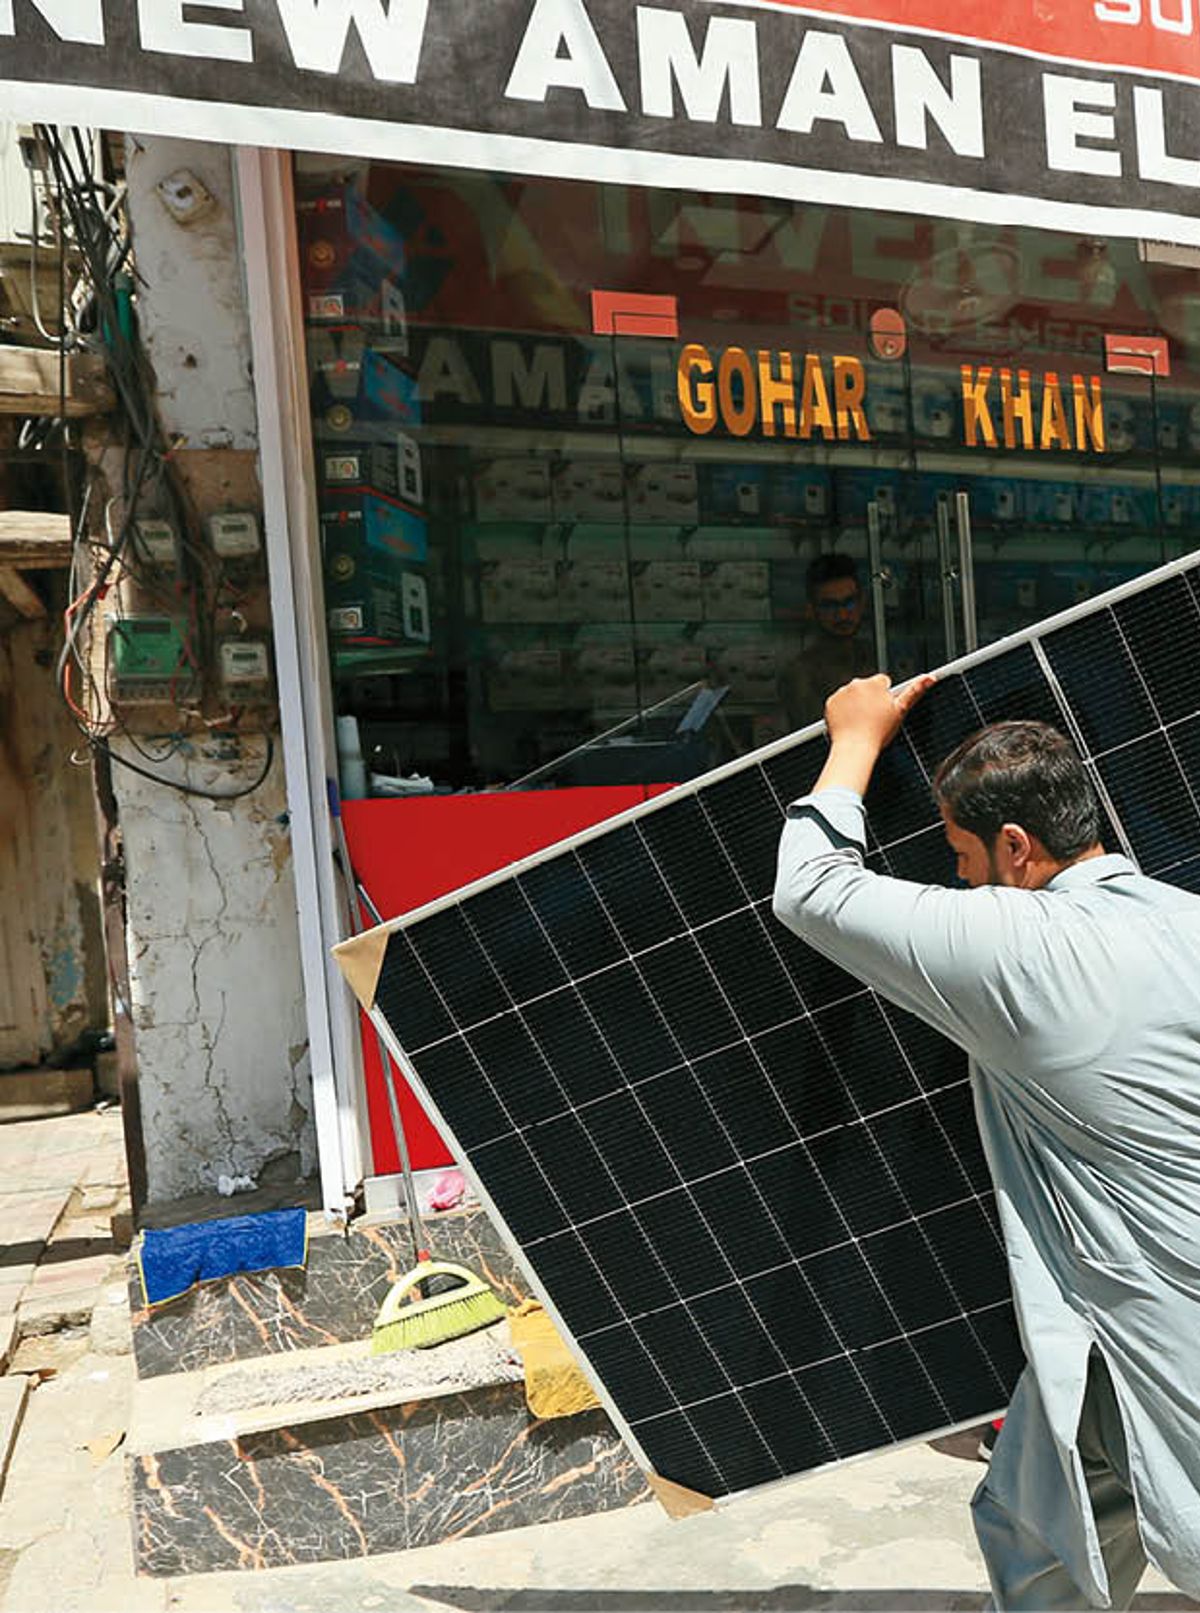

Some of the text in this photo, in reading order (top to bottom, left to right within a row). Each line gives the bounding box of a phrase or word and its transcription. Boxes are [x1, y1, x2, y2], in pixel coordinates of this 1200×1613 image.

[504, 0, 985, 160] AMAN
[676, 343, 871, 442] GOHAR
[960, 363, 1106, 452] KHAN
